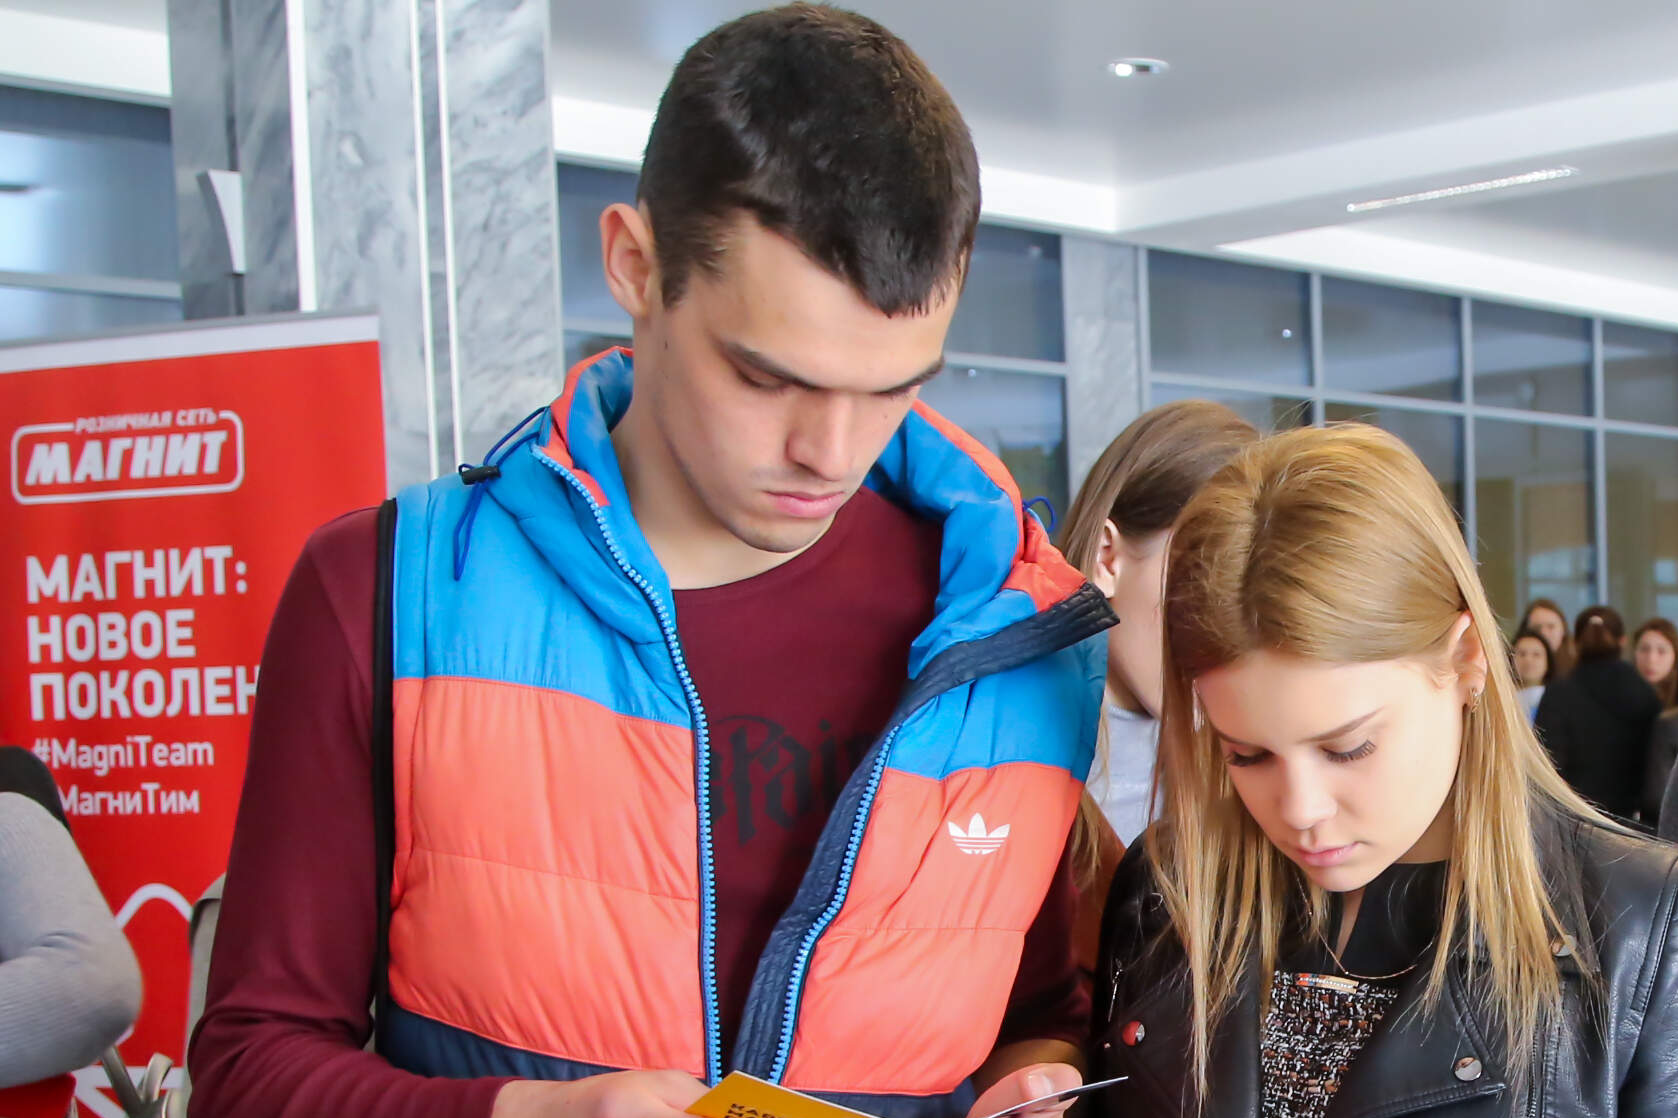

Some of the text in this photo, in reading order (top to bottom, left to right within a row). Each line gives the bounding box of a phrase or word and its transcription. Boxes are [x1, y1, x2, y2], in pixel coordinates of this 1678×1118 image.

[75, 408, 217, 434] РОЗНИЧНАЯ СЕТЬ
[24, 430, 228, 486] МАГНИТ
[26, 545, 248, 604] МАГНИТ:
[27, 609, 196, 663] НОВОЕ
[32, 735, 215, 776] #MagniTeam
